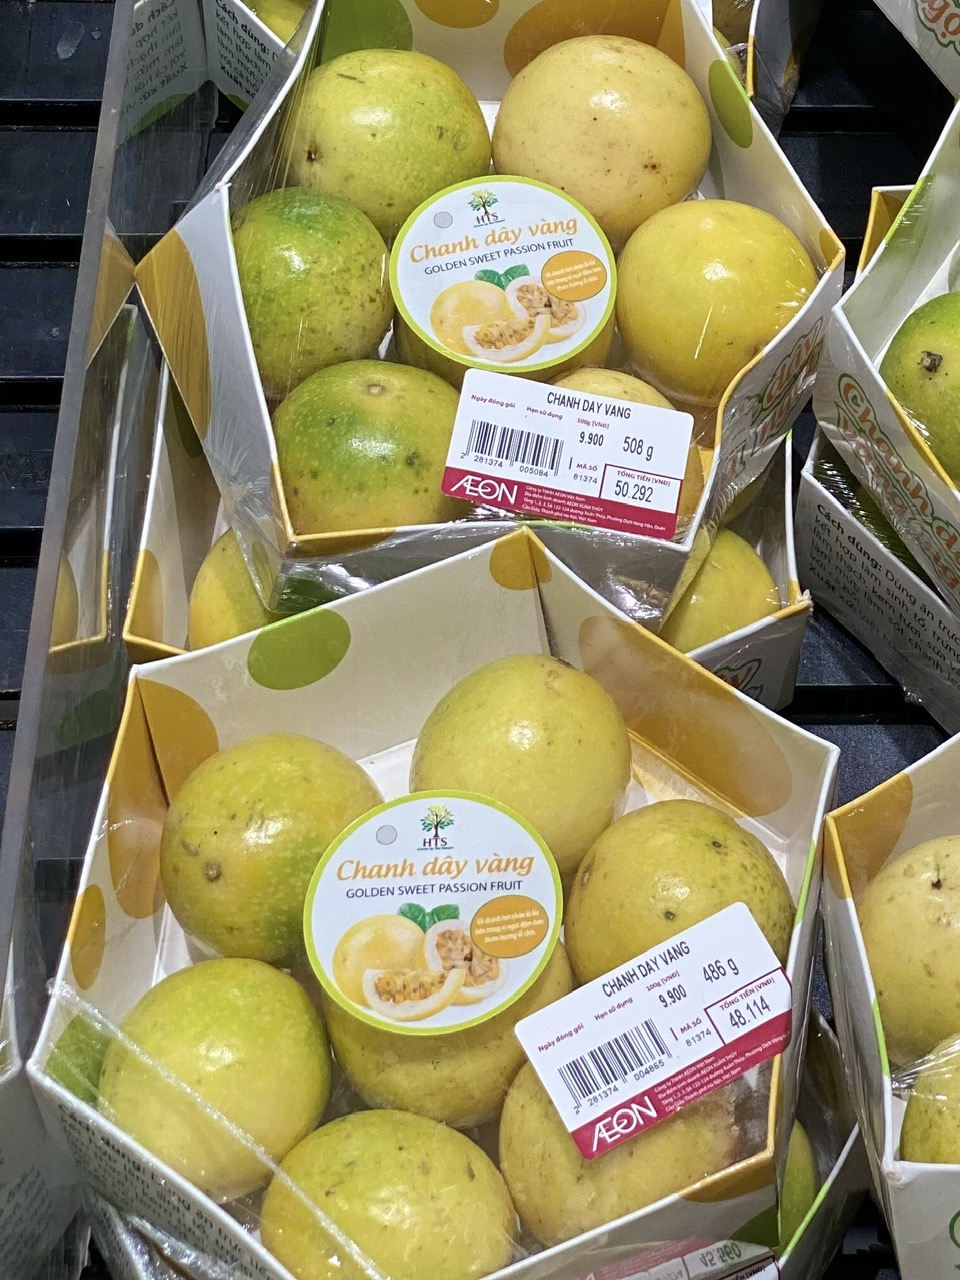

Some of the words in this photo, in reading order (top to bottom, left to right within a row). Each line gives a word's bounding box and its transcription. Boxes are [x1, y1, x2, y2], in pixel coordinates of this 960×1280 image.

[476, 212, 499, 224] HTS
[410, 235, 478, 263] Chanh
[485, 226, 521, 246] dây
[528, 218, 578, 237] vàng
[425, 259, 467, 275] GOLDEN
[469, 251, 501, 266] SWEET
[504, 243, 545, 257] PASSION
[547, 239, 574, 249] FRUIT
[547, 392, 580, 411] CHANH
[582, 399, 602, 414] DAY
[604, 404, 631, 419] VANG
[579, 431, 604, 447] 9.900
[622, 436, 643, 455] 508
[646, 445, 654, 461] g
[615, 480, 653, 503] 50.292
[817, 504, 844, 535] Cách
[847, 535, 882, 571] dùng:
[885, 571, 916, 606] Dùng
[920, 604, 934, 621] ăn
[938, 620, 960, 646] trực
[423, 838, 447, 847] HTS
[336, 859, 415, 881] Chanh
[422, 856, 468, 879] dây
[475, 853, 534, 876] vàng
[346, 887, 394, 899] GOLDEN
[398, 884, 435, 895] SWEET
[439, 882, 487, 893] PASSION
[490, 880, 523, 891] FRUIT
[602, 970, 640, 998] CHANH
[638, 956, 661, 977] DAY
[661, 941, 690, 966] VANG
[658, 984, 687, 1008] 9.900
[701, 959, 725, 983] 486
[727, 957, 739, 976] g
[729, 996, 771, 1030] 48.114
